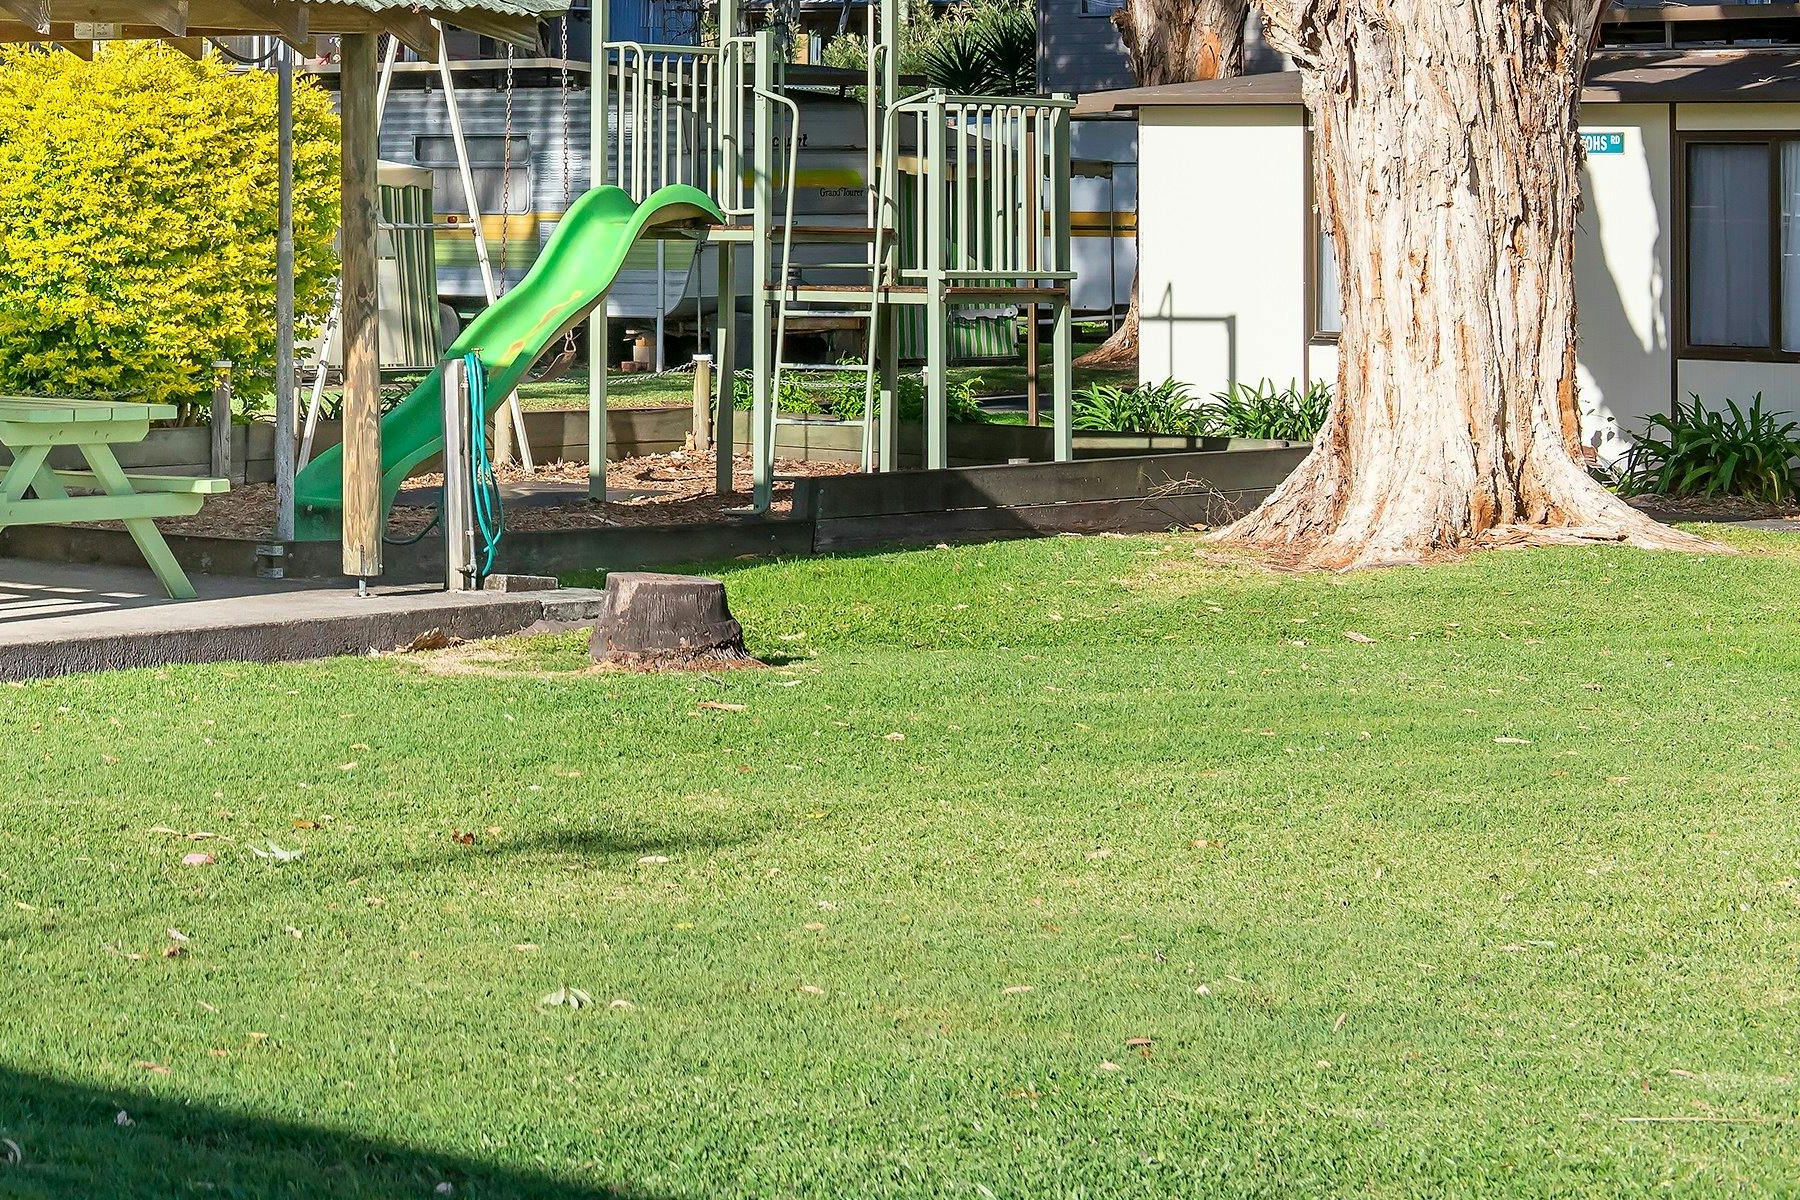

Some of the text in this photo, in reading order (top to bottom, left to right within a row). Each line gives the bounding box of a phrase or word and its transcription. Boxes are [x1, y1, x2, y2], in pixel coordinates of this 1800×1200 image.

[1611, 135, 1621, 145] RD
[820, 187, 863, 197] Grand Tourer
